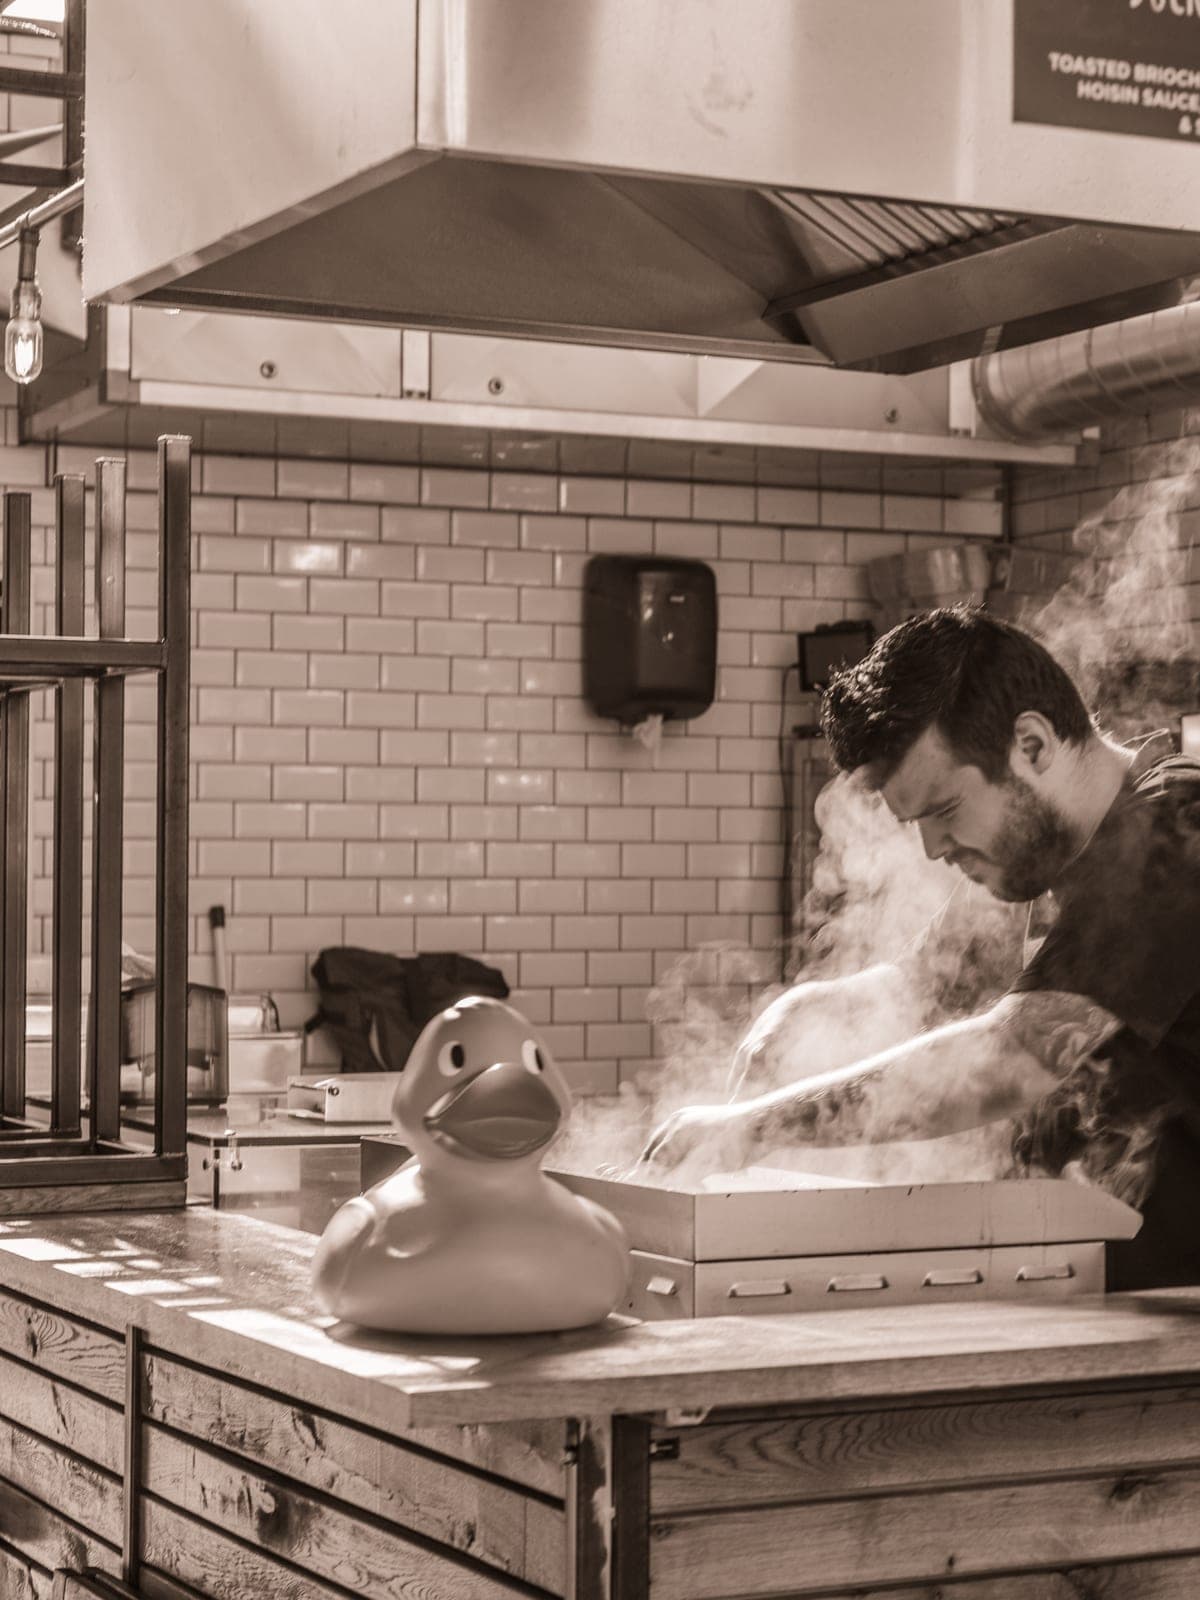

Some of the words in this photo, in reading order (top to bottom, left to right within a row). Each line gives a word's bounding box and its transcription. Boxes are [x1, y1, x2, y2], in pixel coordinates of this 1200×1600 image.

[1049, 51, 1131, 80] TOASTED
[1077, 80, 1140, 104] HOISIN
[1178, 115, 1193, 134] &
